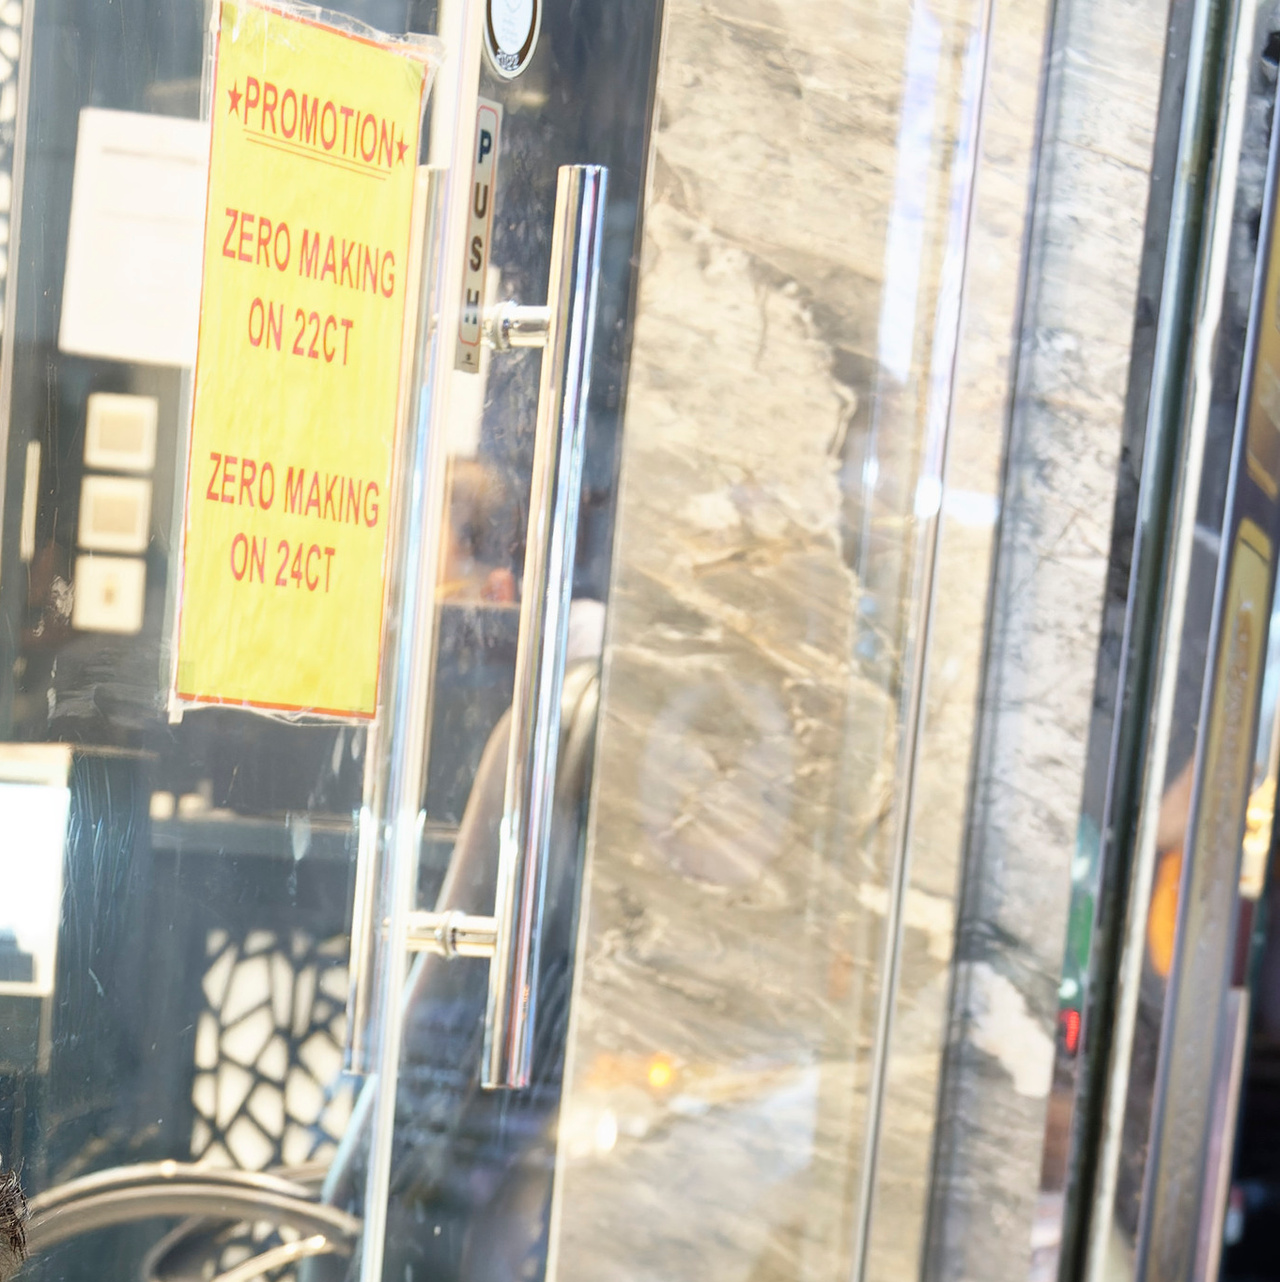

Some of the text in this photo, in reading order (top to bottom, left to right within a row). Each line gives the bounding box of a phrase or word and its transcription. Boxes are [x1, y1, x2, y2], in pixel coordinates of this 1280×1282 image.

[244, 75, 395, 168] PROMOTION
[222, 207, 395, 299] ZERO MAKING
[464, 128, 492, 325] PUSH
[248, 297, 354, 366] ON 22CT
[206, 451, 379, 528] ZERO MAKING
[230, 532, 336, 594] ON 24CT
